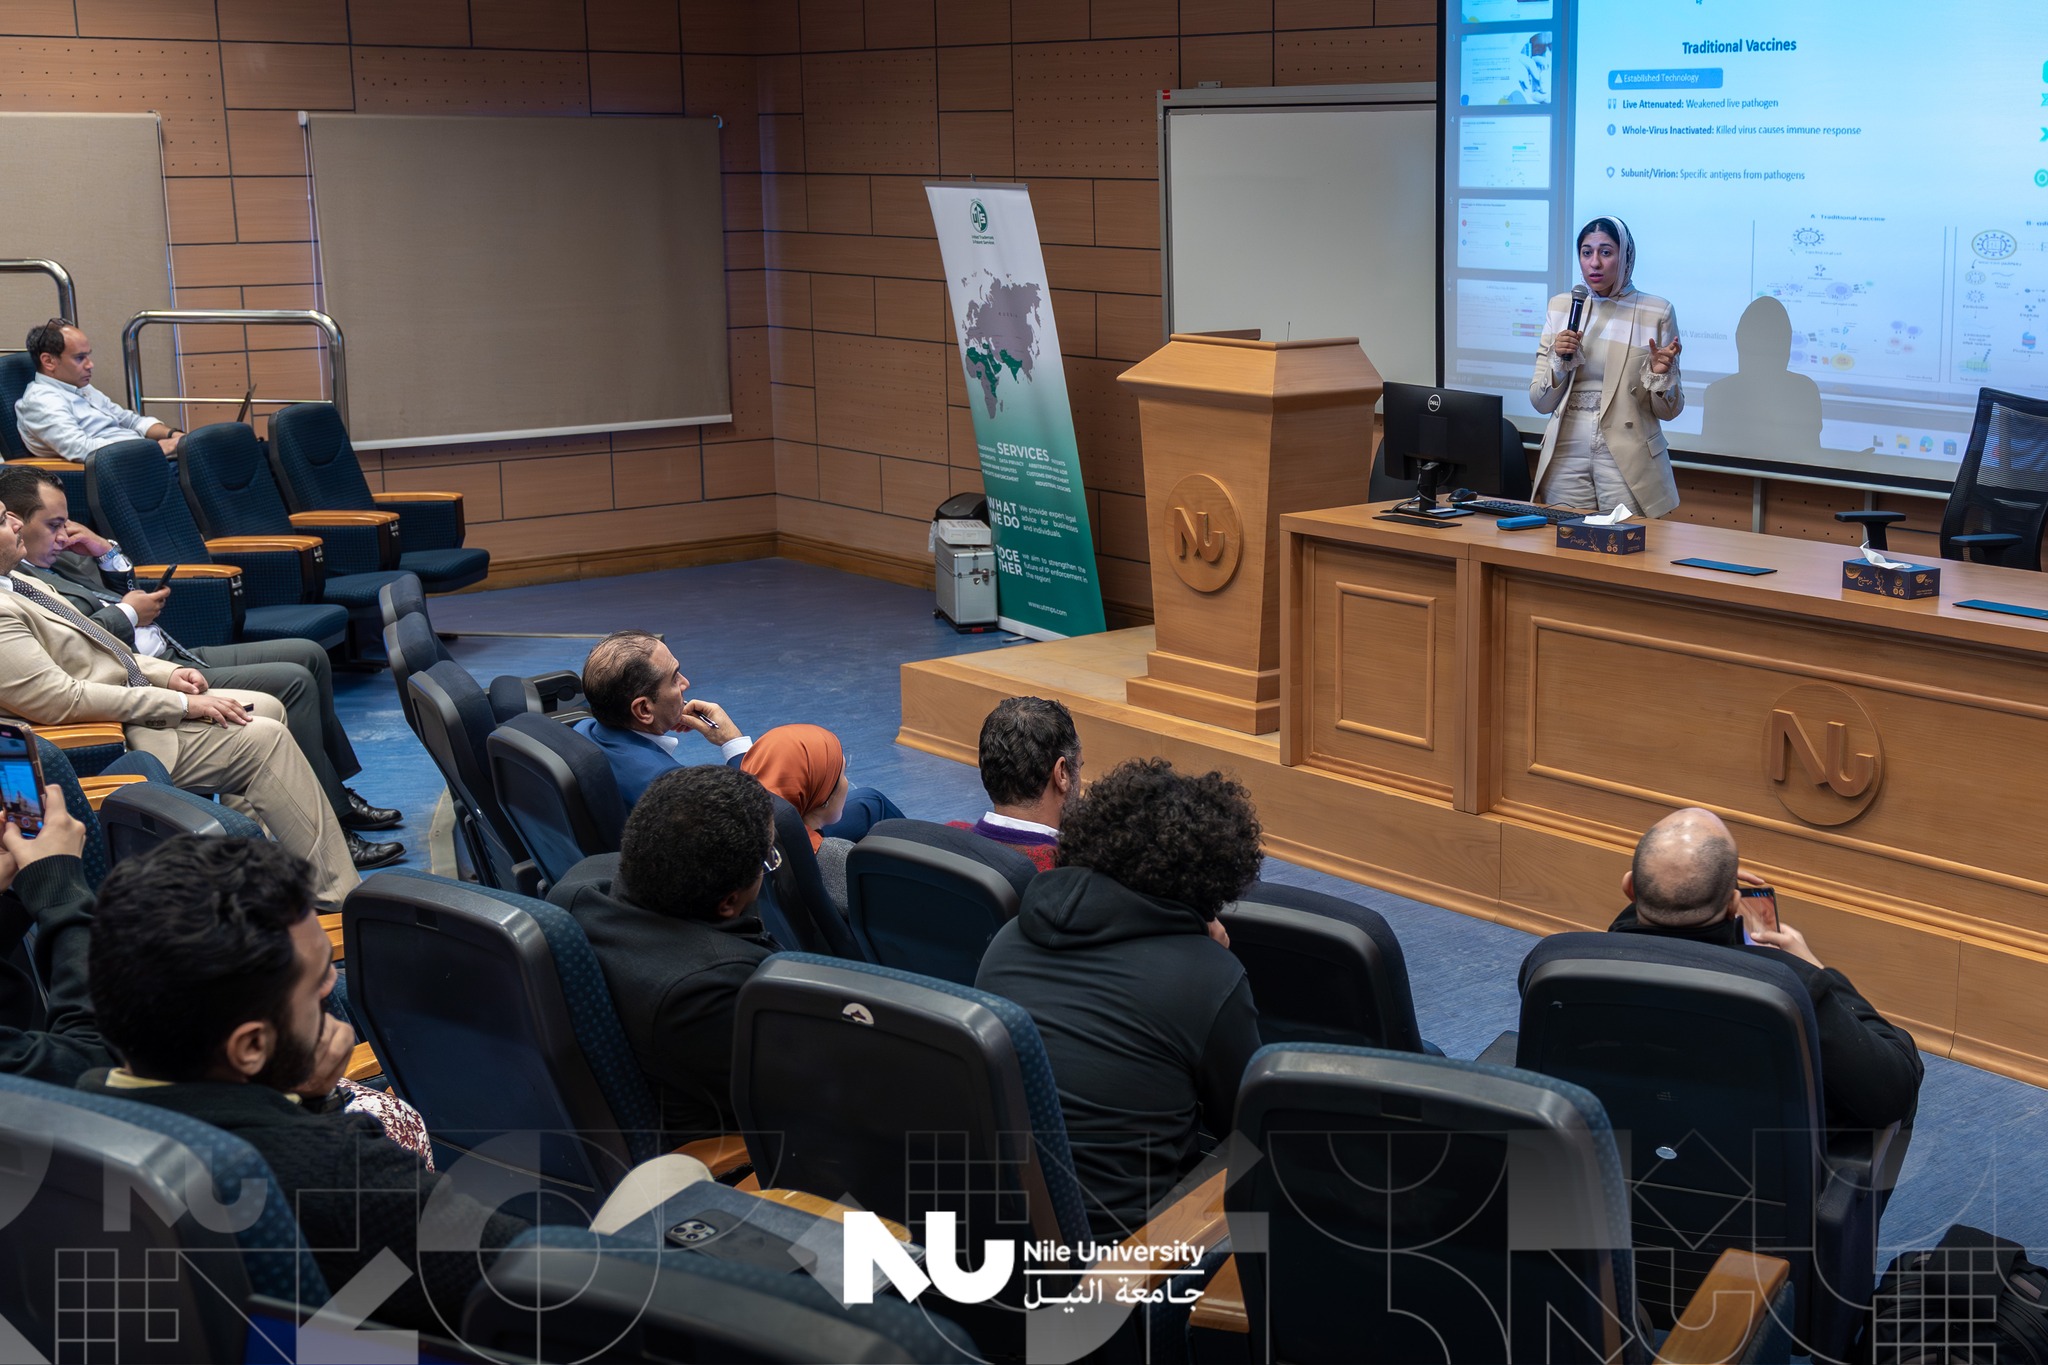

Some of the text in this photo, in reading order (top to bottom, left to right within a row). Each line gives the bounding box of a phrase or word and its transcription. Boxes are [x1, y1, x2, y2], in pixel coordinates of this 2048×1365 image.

[1682, 37, 1797, 54] Traditional Vaccines
[1624, 73, 1699, 84] Established Technology
[1622, 98, 1779, 110] Live Attenuated: Weakened live pathogen
[1622, 126, 1862, 137] Whole-Virus Inactivated: Killed virus causes immune response
[1621, 168, 1805, 182] Subunit/Virion: Specific antigens from pathogens
[997, 442, 1050, 462] SERVICES
[987, 495, 1017, 515] WHAT
[1029, 507, 1048, 517] provide
[990, 509, 1003, 525] WE
[1003, 514, 1020, 529] DO
[1021, 515, 1079, 533] advice for businesses
[1023, 524, 1033, 532] and
[1174, 506, 1226, 564] NU
[998, 557, 1023, 576] THER
[1023, 561, 1038, 572] future
[1050, 569, 1083, 582] enforcement
[1031, 554, 1040, 562] aim
[1041, 557, 1048, 565] to
[1048, 559, 1077, 571] strengthen
[1078, 565, 1086, 574] the
[1025, 571, 1034, 579] the
[1769, 708, 1875, 798] NU
